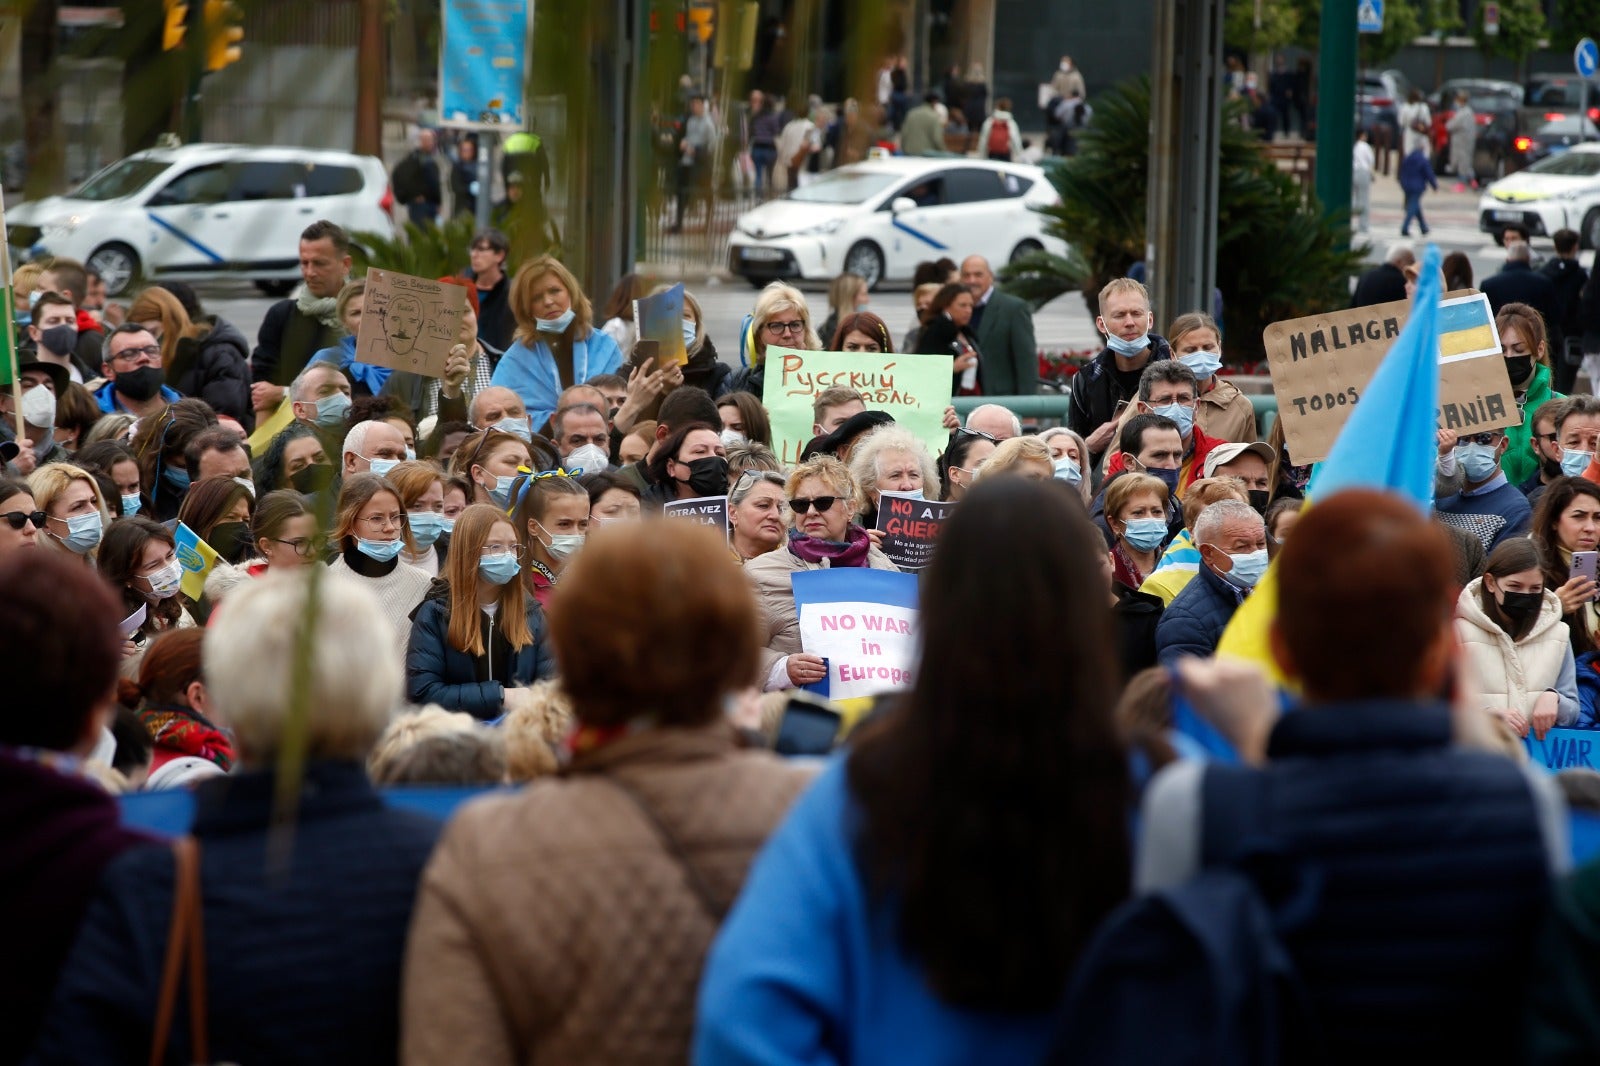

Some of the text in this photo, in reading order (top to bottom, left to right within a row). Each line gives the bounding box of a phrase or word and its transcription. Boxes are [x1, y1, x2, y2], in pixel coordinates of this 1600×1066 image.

[779, 354, 896, 397] Русский
[1292, 387, 1360, 416] TODOS
[669, 505, 721, 518] OTRA VEZ
[890, 499, 955, 520] NO A L
[700, 517, 716, 526] LA
[886, 517, 944, 538] GUER
[904, 548, 914, 556] No
[820, 614, 913, 636] NO WAR
[861, 638, 882, 656] in
[838, 664, 912, 685] Europe
[1541, 736, 1596, 771] WAR
